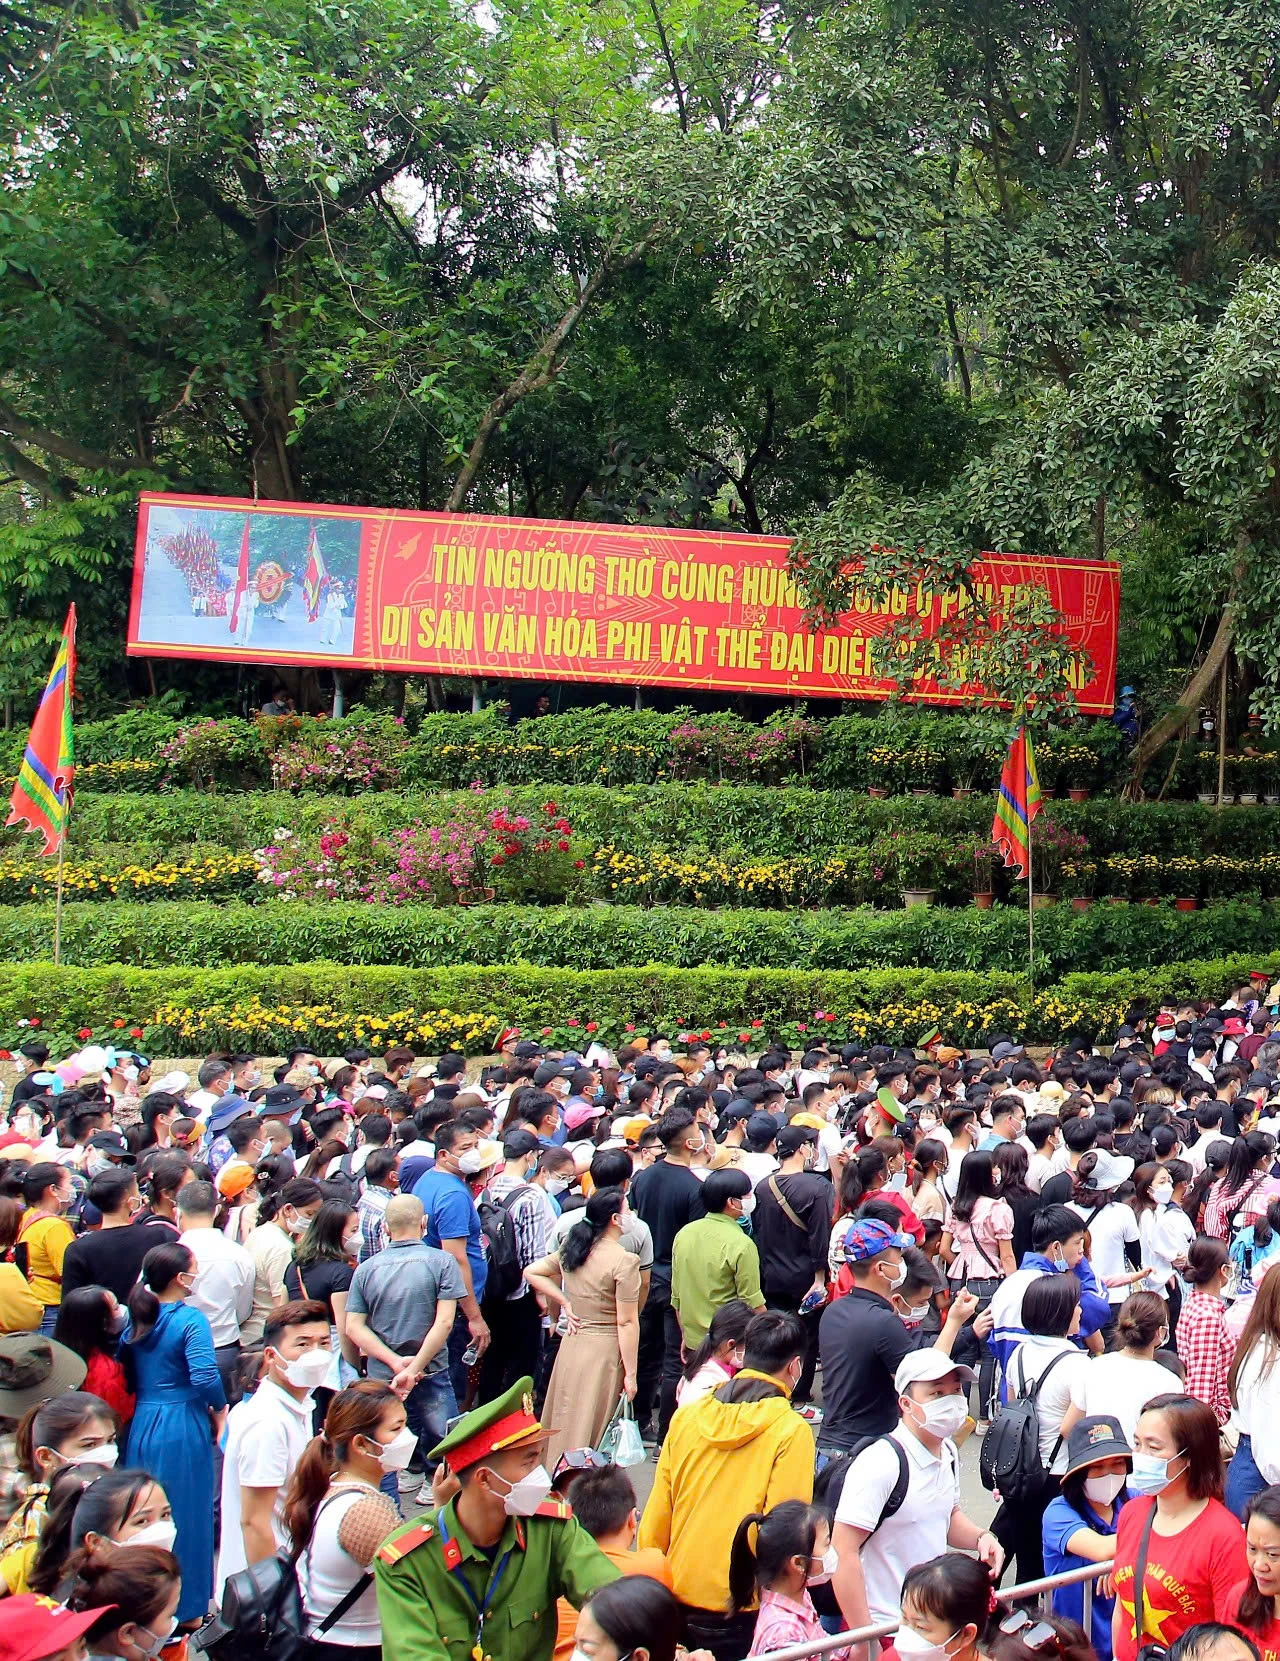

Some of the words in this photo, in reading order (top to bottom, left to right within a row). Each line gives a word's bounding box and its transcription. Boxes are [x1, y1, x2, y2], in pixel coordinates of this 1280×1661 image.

[432, 537, 476, 586] TÍN
[483, 541, 596, 594] NGƯỠNG
[604, 548, 657, 598] THỜ
[661, 553, 734, 604] CÚNG
[741, 560, 809, 610] HÙN
[381, 605, 410, 647] DI
[417, 592, 475, 651] SẢN
[483, 604, 537, 655] VĂN
[544, 609, 598, 659] HÓA
[605, 619, 652, 662] PHI
[660, 616, 709, 674] VẬT
[716, 614, 767, 669] THỂ
[770, 632, 815, 681] ĐẠI
